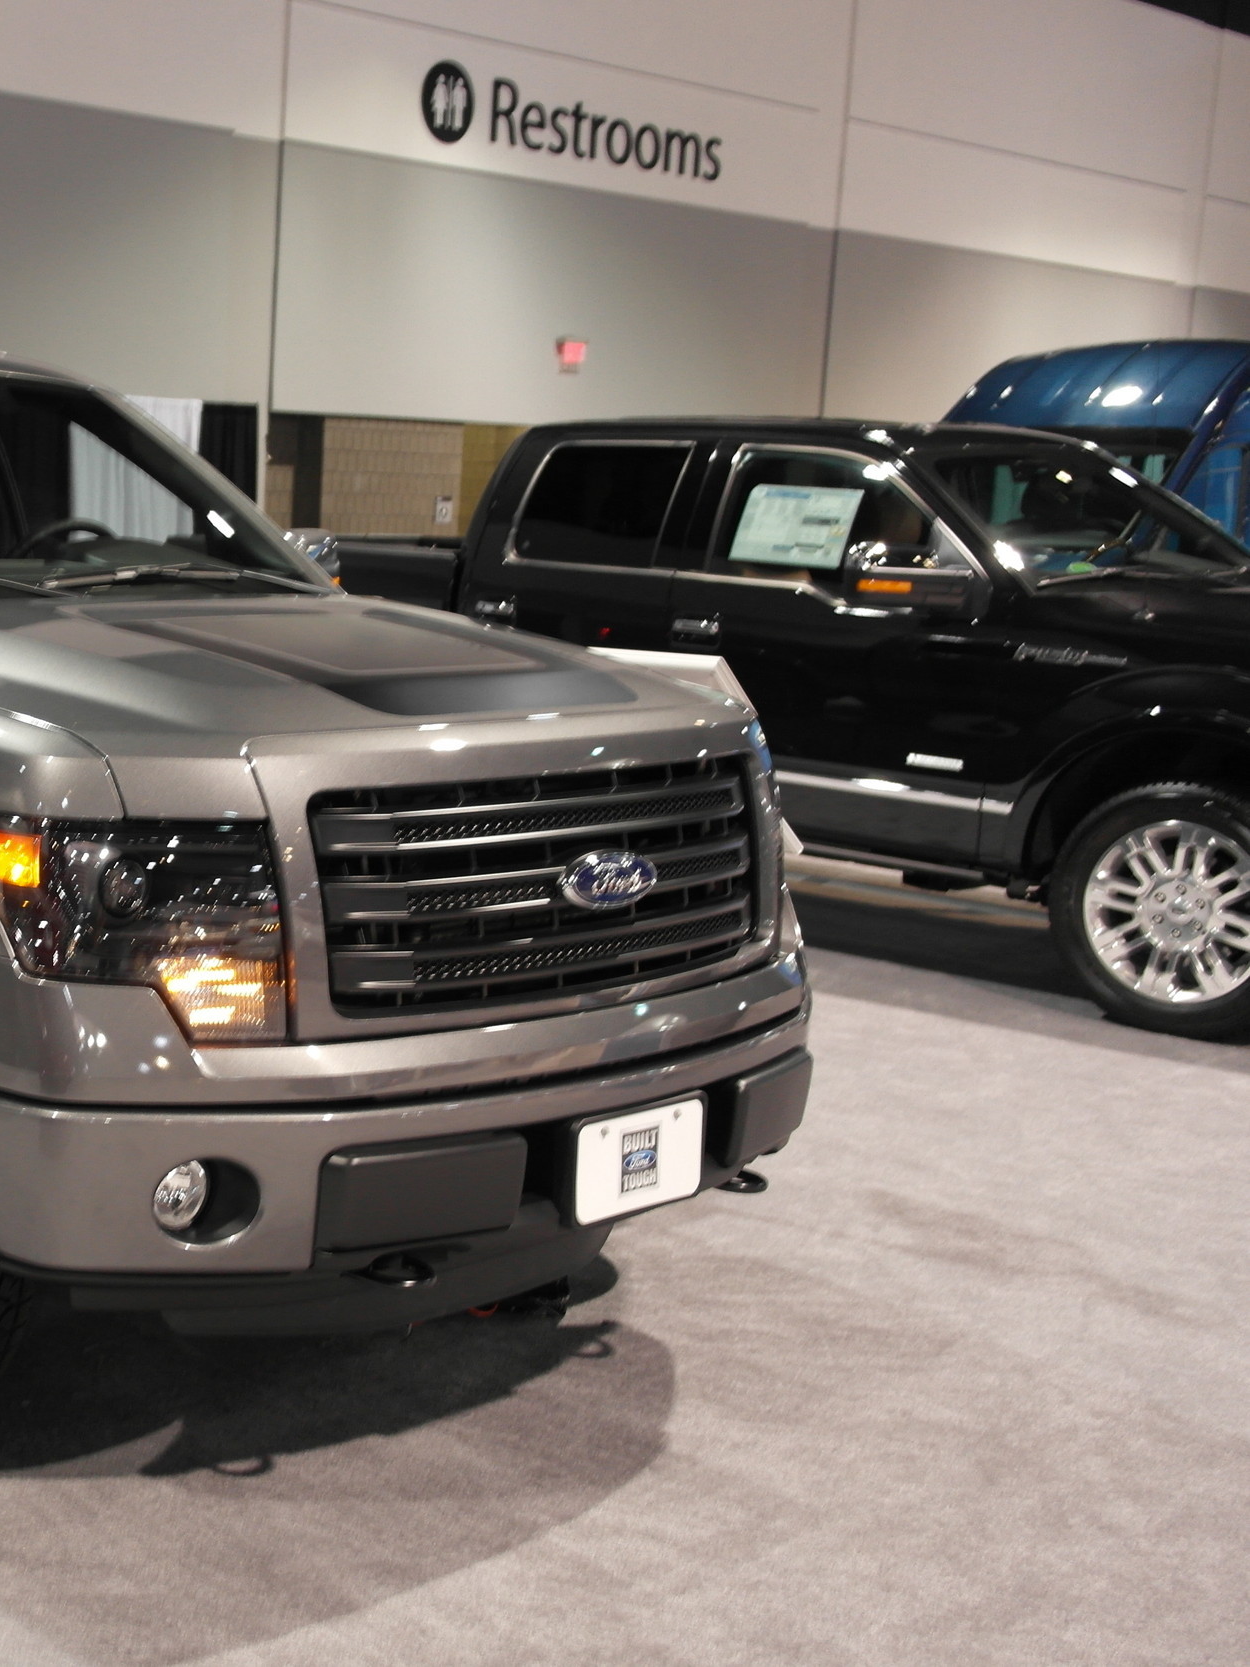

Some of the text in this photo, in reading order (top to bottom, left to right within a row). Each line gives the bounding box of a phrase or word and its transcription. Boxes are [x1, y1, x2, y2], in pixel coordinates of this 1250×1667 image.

[490, 76, 723, 182] Restrooms
[623, 1129, 658, 1154] BUILT
[623, 1168, 657, 1192] TOUGH
